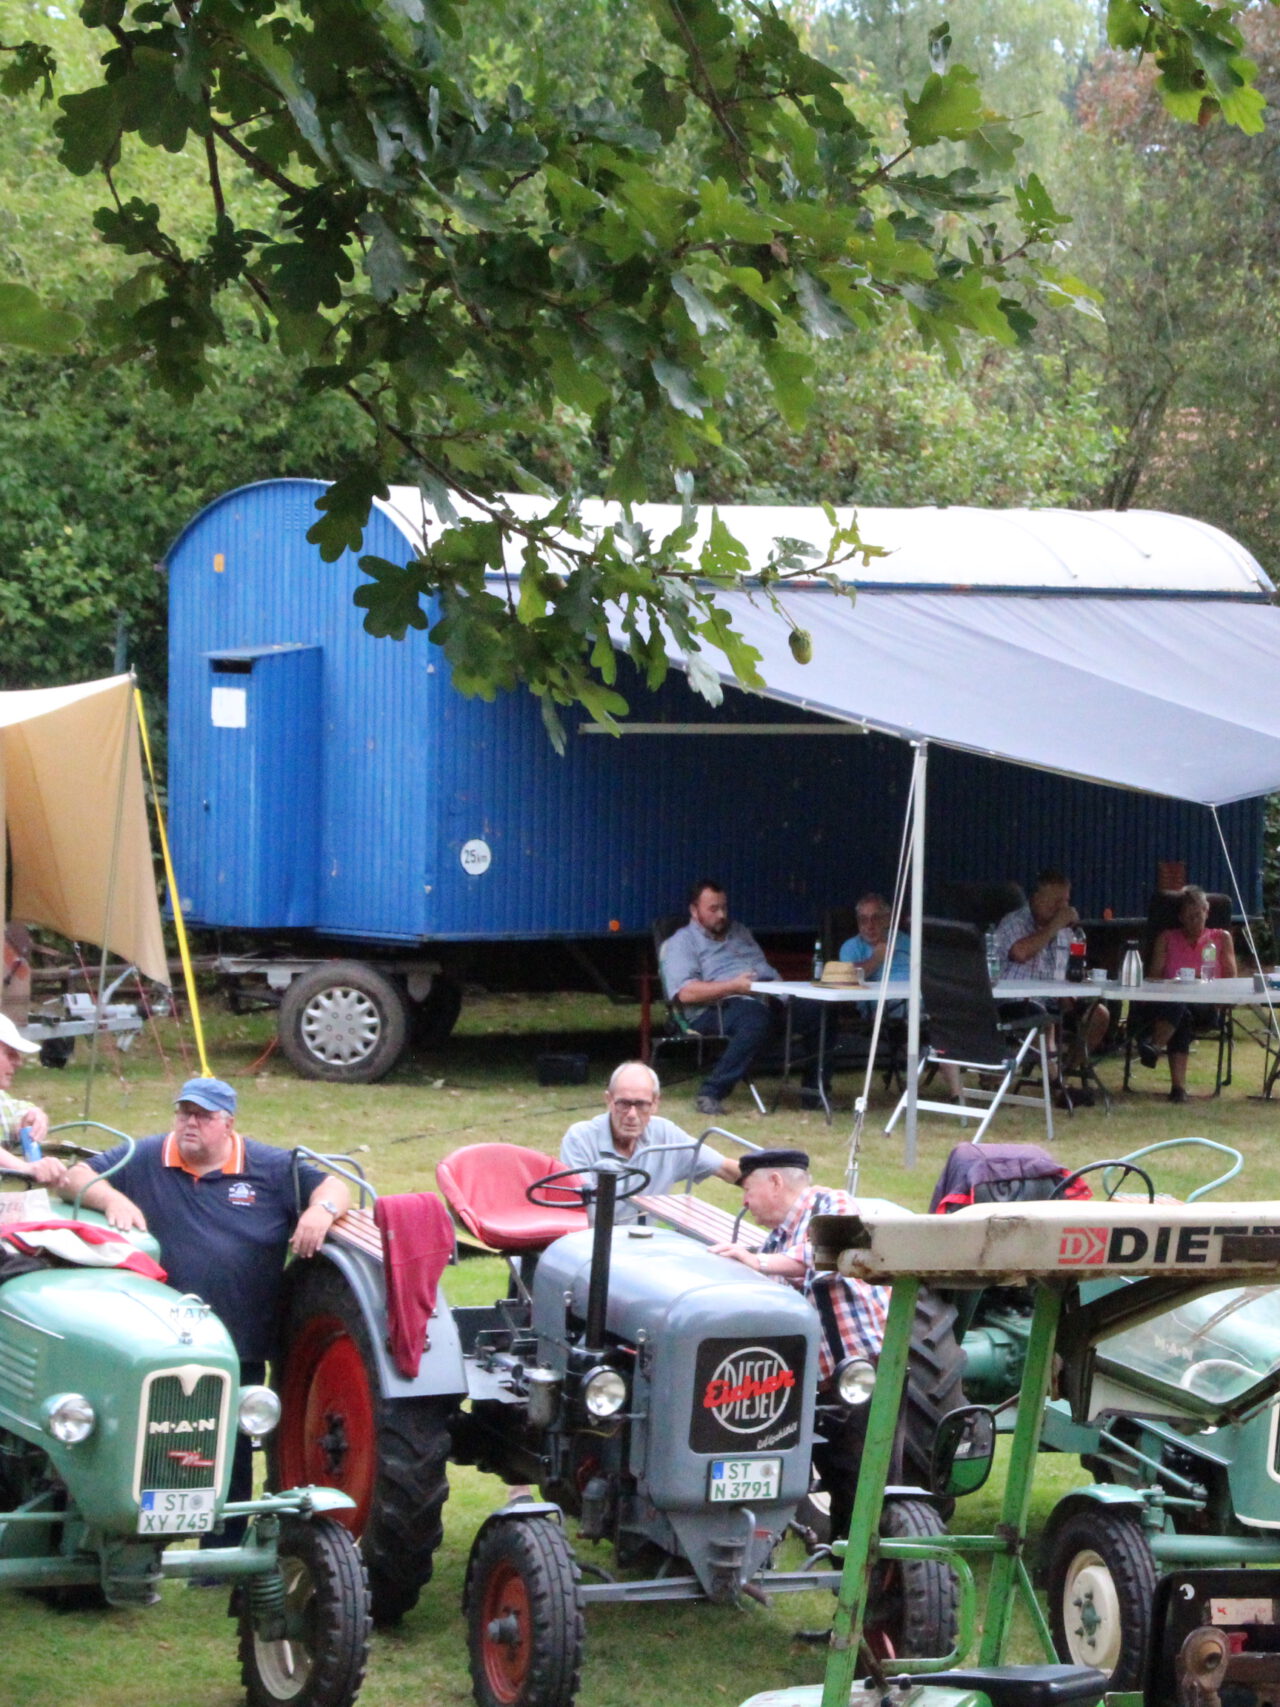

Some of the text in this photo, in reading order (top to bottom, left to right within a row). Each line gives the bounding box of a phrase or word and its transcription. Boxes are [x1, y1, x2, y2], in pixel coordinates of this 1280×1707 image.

[703, 1370, 796, 1408] Eicher
[720, 1360, 778, 1420] DIESEL
[728, 1463, 751, 1480] ST
[715, 1481, 772, 1499] N 3791
[164, 1494, 189, 1511] ST
[144, 1513, 208, 1532] XY 745
